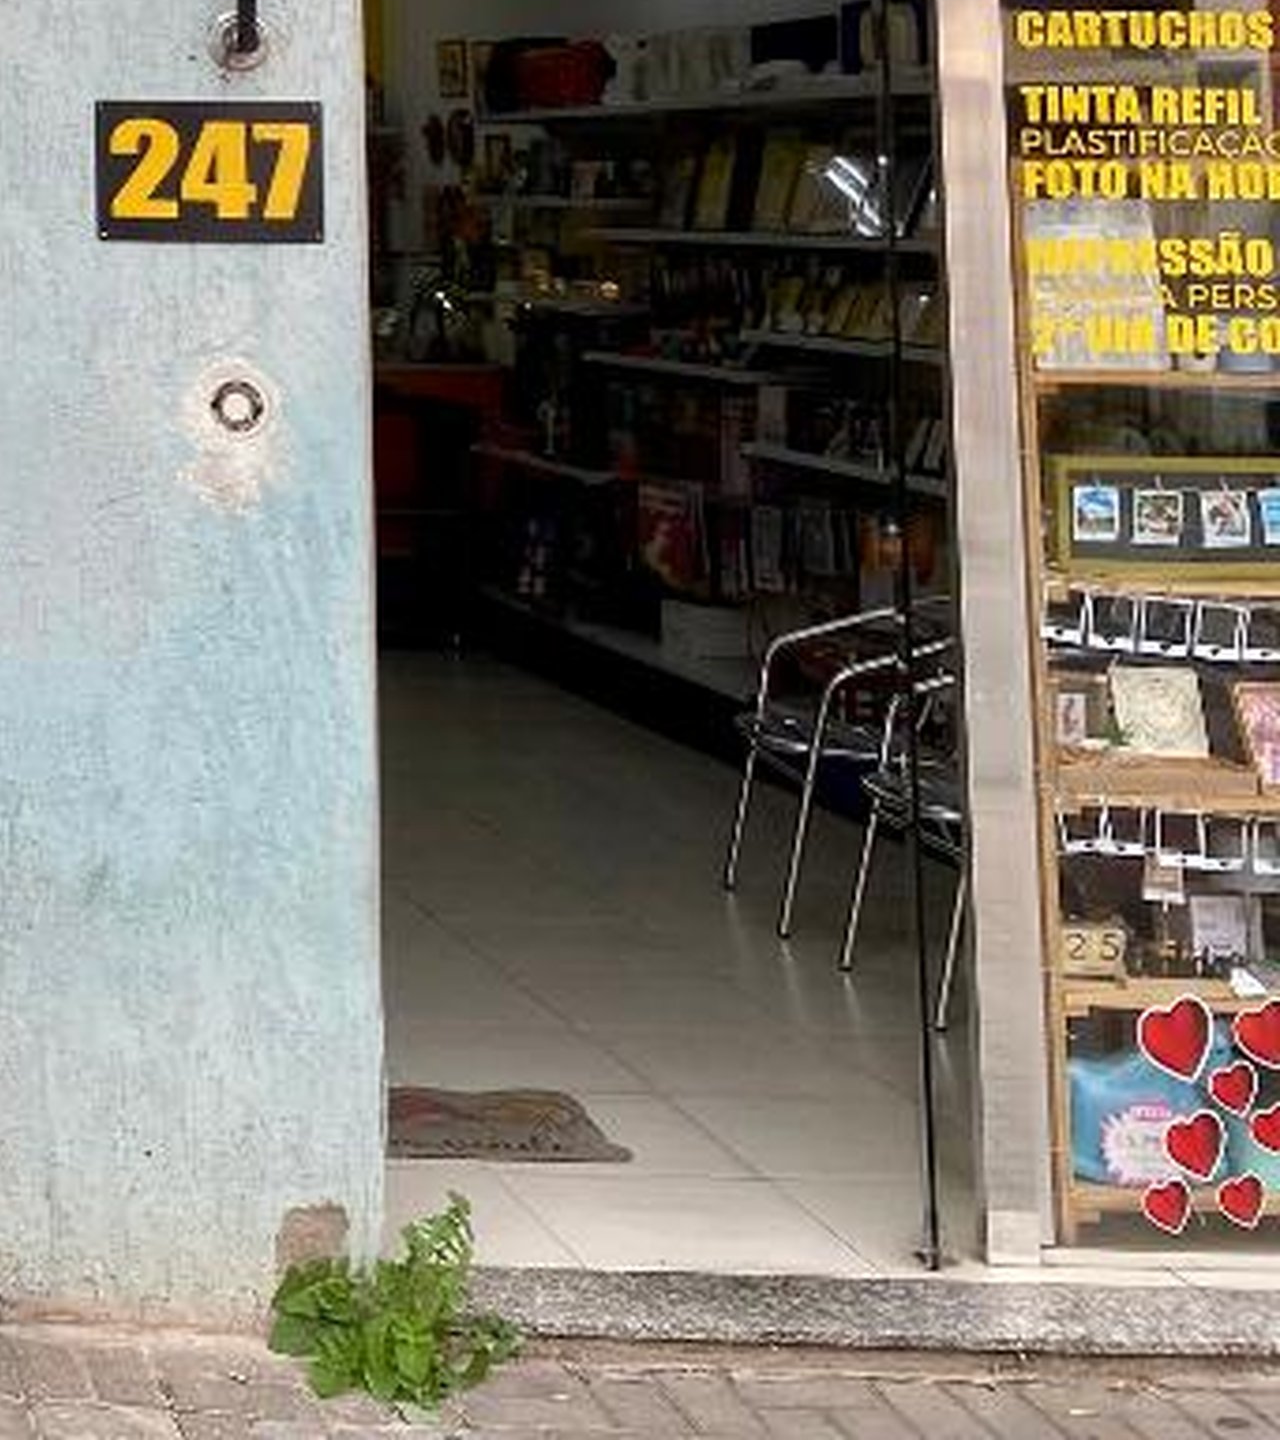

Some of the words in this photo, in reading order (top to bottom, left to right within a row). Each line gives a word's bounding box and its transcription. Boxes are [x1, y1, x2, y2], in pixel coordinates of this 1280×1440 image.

[1016, 10, 1274, 49] CARTUCHOS
[1020, 86, 1142, 123] TINTA
[1151, 88, 1262, 124] REFIL
[109, 117, 310, 220] 247
[1023, 160, 1127, 199] FOTO
[1141, 161, 1198, 199] NA
[1166, 316, 1220, 354] DE
